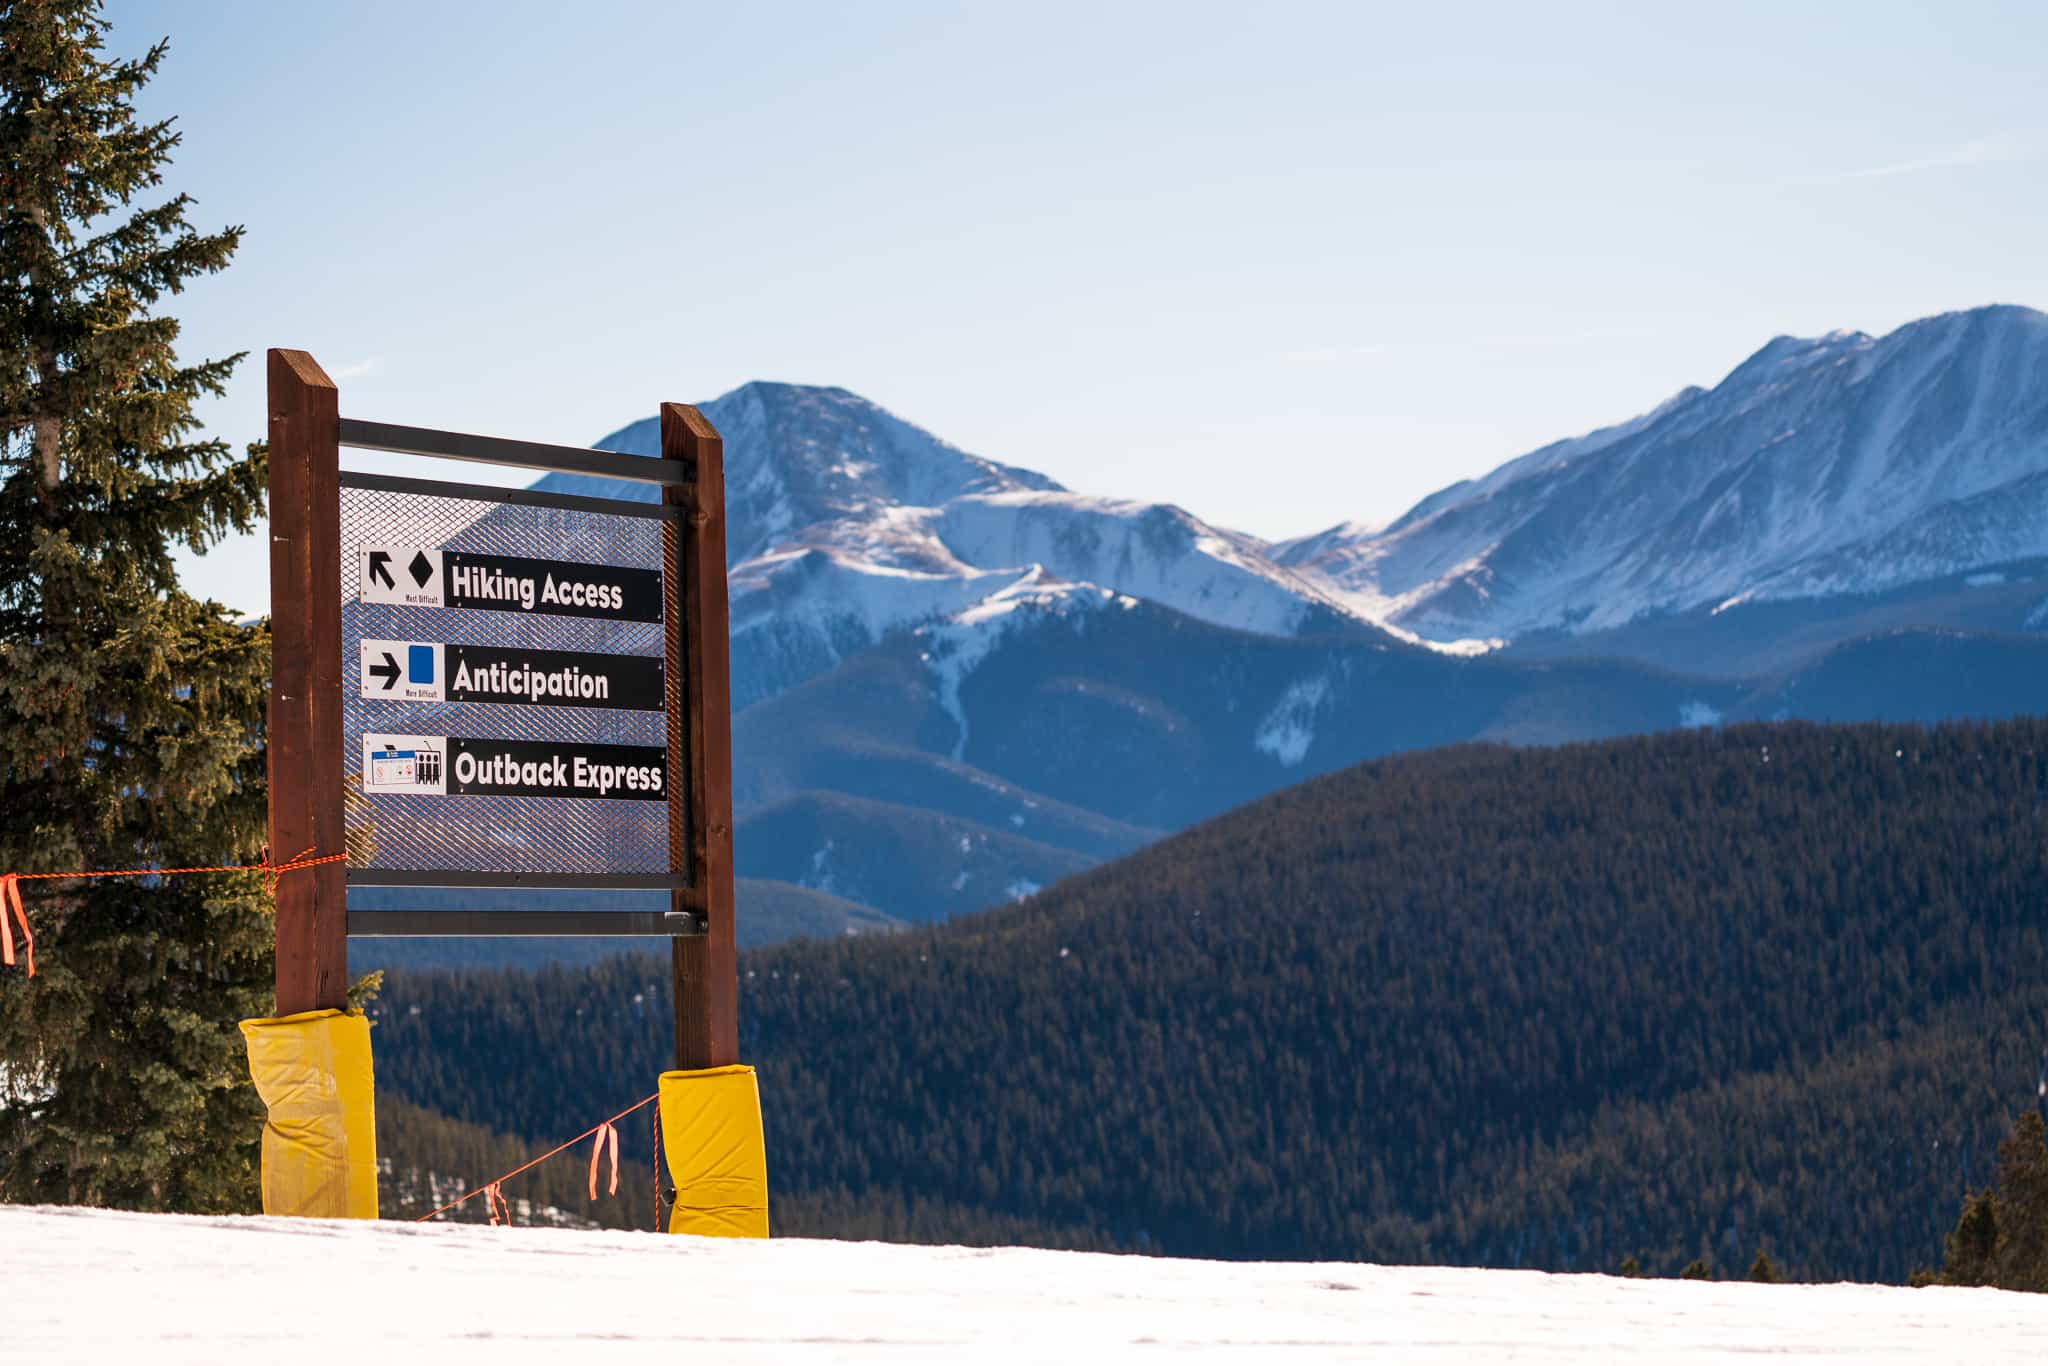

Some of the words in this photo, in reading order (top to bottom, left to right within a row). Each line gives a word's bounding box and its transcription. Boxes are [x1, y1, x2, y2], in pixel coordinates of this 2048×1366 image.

[452, 565, 535, 610] Hiking
[541, 572, 624, 610] Access
[452, 658, 609, 702] Anticipation
[455, 751, 568, 786] Outback
[573, 756, 663, 795] Express
